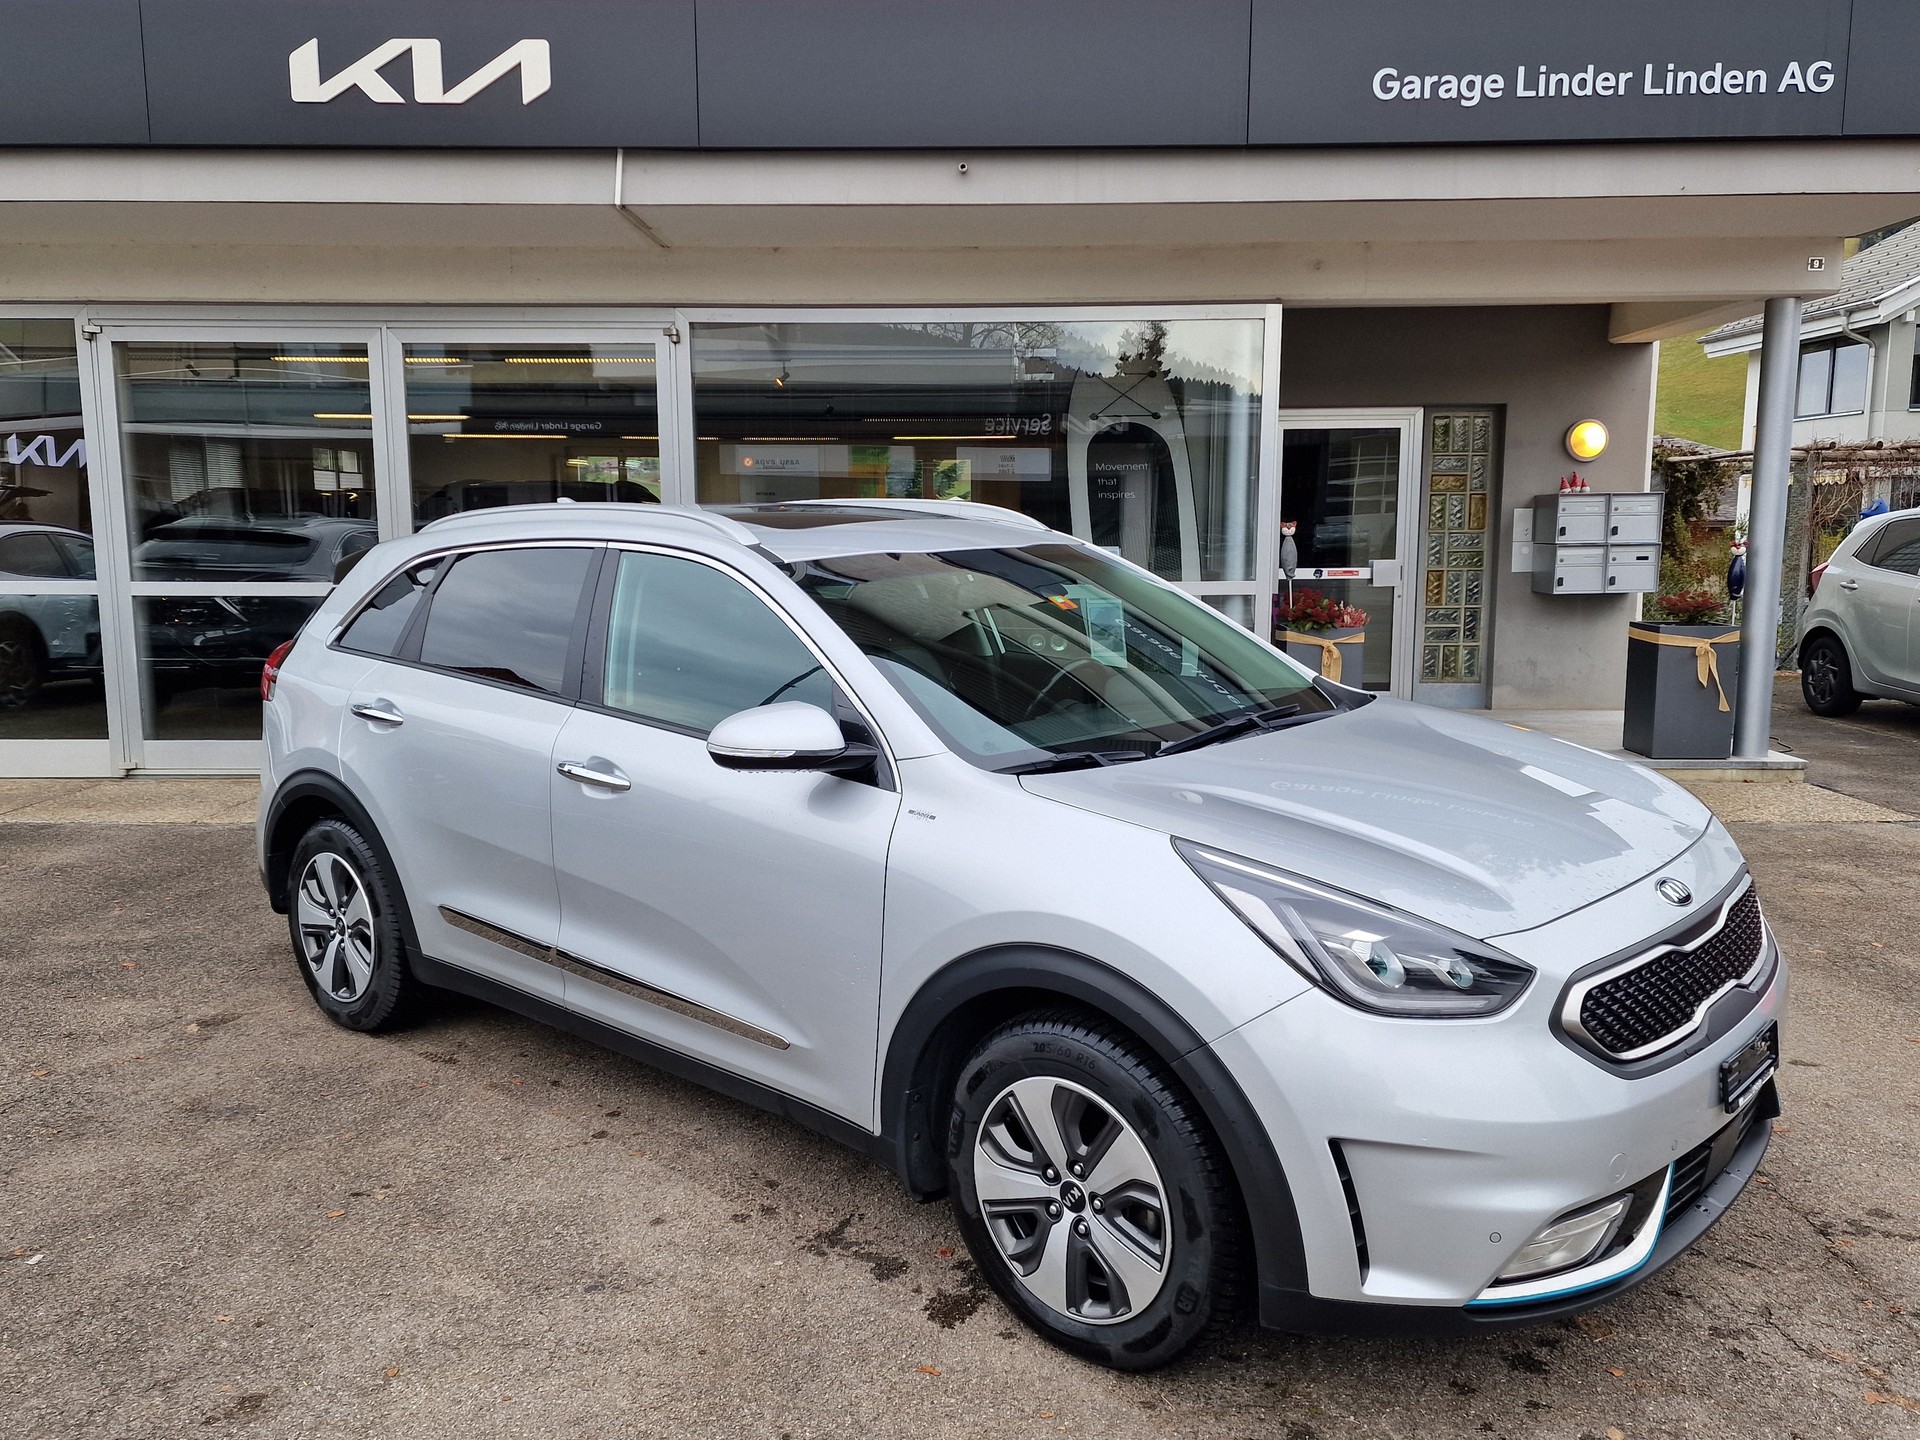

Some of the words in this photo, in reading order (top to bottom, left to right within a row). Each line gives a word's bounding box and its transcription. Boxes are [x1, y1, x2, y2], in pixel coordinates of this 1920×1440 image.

[289, 37, 551, 106] KIA
[1372, 66, 1505, 107] Garage
[1515, 64, 1633, 98] Linder
[1642, 62, 1767, 96] Linden
[1777, 60, 1836, 94] AG
[7, 432, 87, 468] KIA
[1095, 463, 1149, 471] Movement
[1097, 478, 1117, 486] that
[1098, 490, 1136, 500] inspires
[1033, 1042, 1072, 1058] 205/60
[1075, 1052, 1096, 1070] R16
